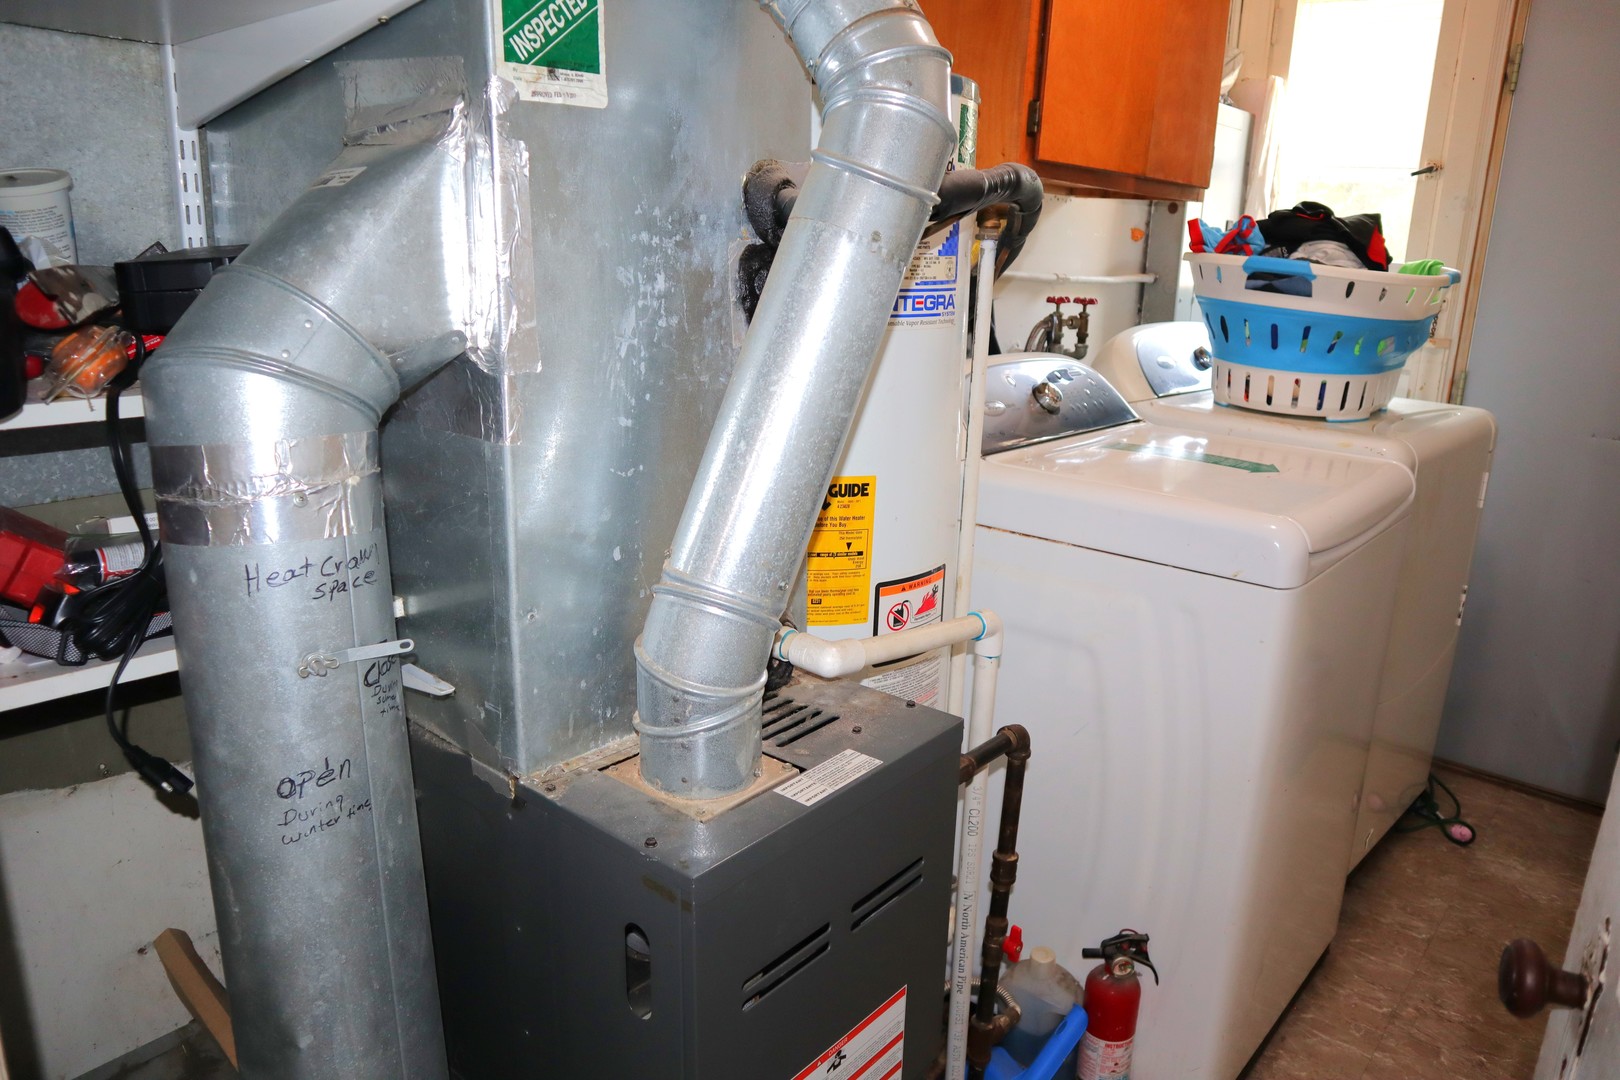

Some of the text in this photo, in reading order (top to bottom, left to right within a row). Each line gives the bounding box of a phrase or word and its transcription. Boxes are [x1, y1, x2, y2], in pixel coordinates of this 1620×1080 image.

[827, 482, 870, 499] GUIDE
[242, 556, 313, 598] Heat
[967, 808, 981, 837] CL200
[961, 904, 972, 930] North
[957, 932, 970, 975] American
[956, 975, 967, 995] Pipe
